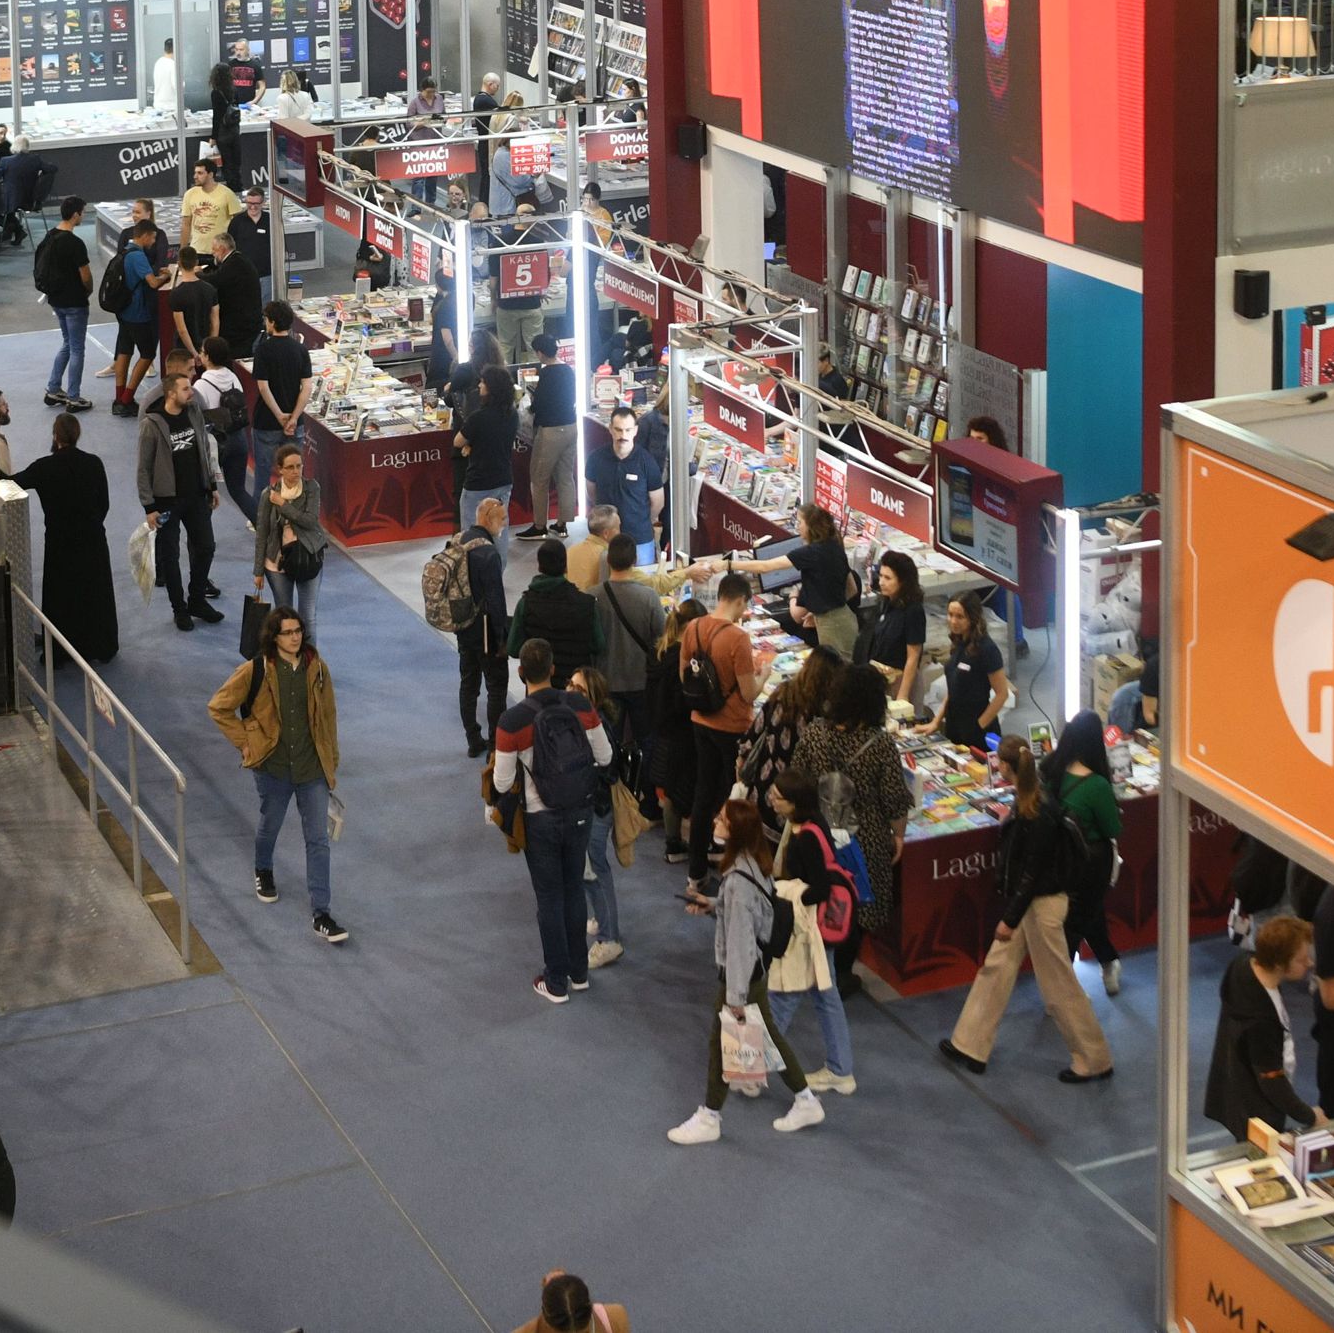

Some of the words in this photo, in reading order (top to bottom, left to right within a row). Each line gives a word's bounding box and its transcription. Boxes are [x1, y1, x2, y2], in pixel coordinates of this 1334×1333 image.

[119, 138, 175, 165] Orhan
[402, 147, 449, 163] DOMAĆI
[532, 143, 548, 153] 10%
[533, 153, 548, 163] 15%
[120, 152, 180, 186] Pamuk
[405, 161, 447, 175] AUTORI
[374, 218, 395, 238] DOMAĆI
[375, 234, 394, 252] AUTORI
[509, 254, 539, 265] KASA
[515, 264, 533, 286] 5
[604, 273, 655, 306] PREPORUČUJEMO
[719, 405, 747, 432] DRAME
[370, 448, 442, 468] Laguna
[870, 488, 905, 517] DRAME
[1206, 1281, 1245, 1332] МИ
